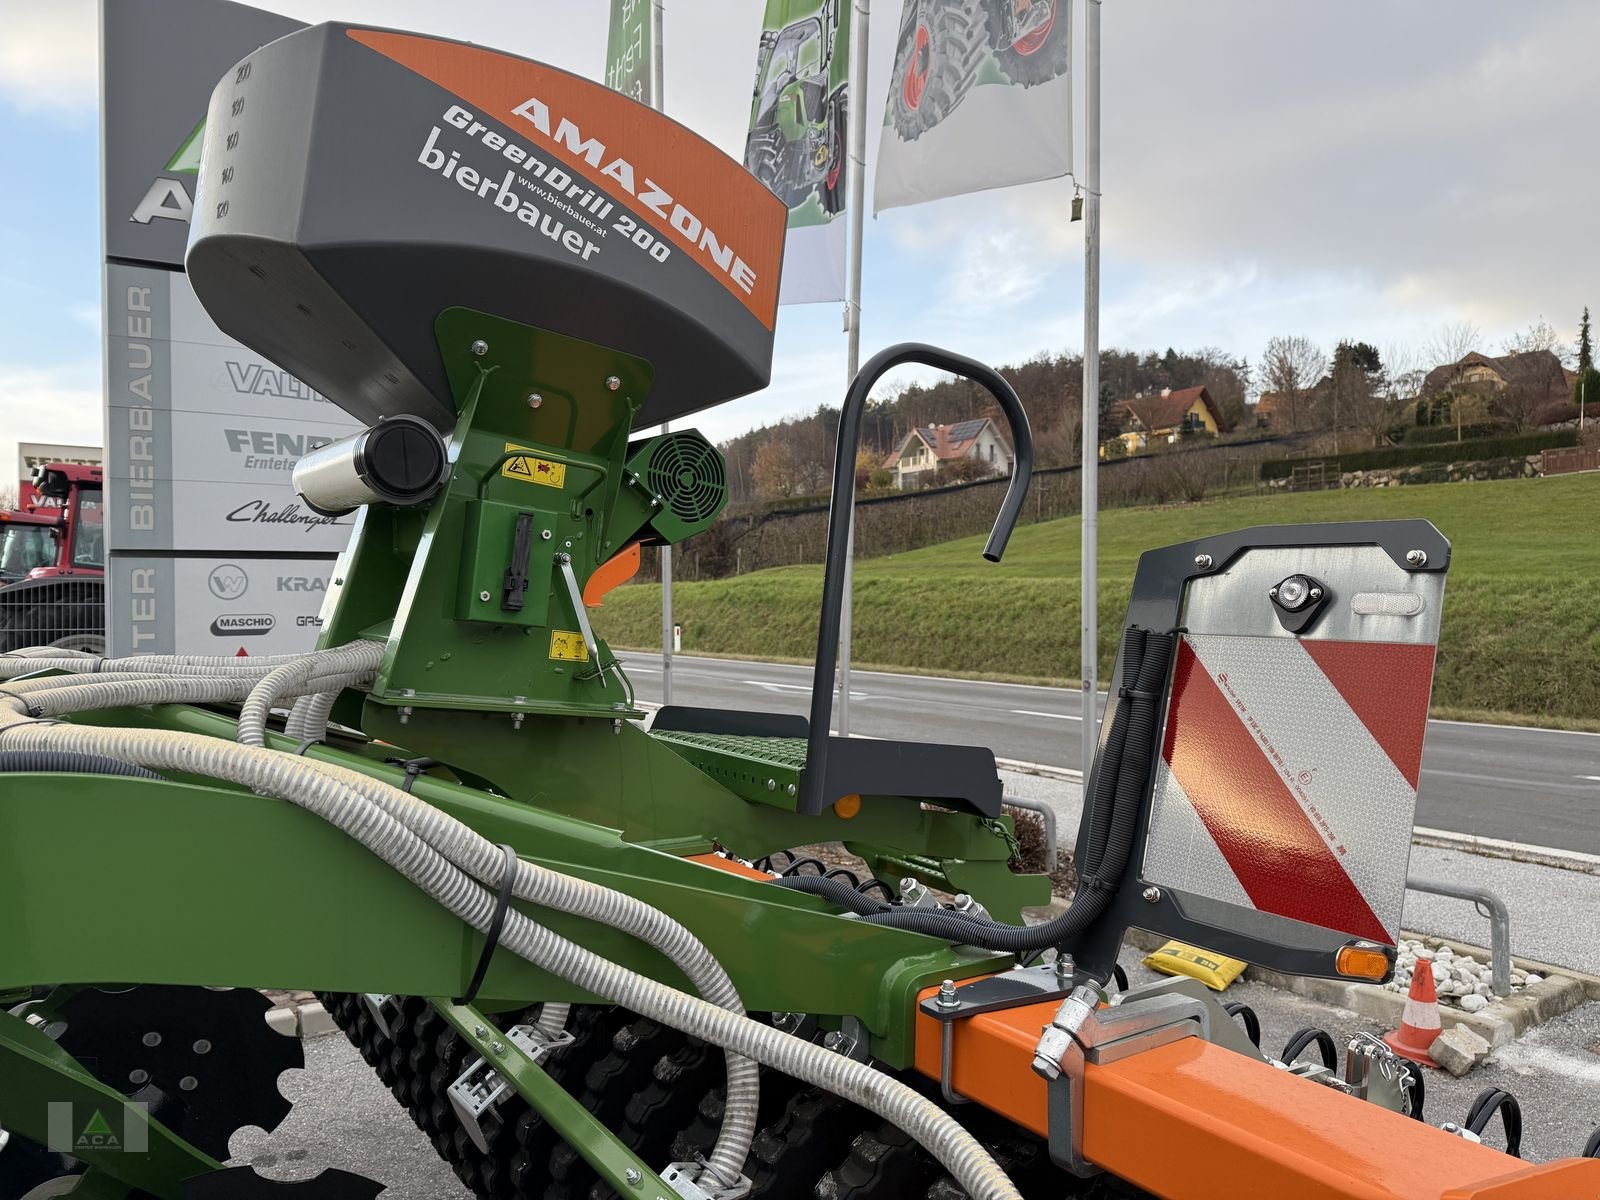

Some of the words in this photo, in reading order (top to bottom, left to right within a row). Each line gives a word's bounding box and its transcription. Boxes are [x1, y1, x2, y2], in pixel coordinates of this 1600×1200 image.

[235, 62, 252, 84] 200
[216, 200, 230, 219] 120
[417, 126, 601, 261] bierbauer
[442, 104, 614, 221] GreenDrill
[612, 215, 671, 263] 200
[511, 97, 757, 295] AMAZONE
[517, 174, 607, 238] www.bierbauer.at
[127, 286, 155, 531] BIERBAUER
[225, 500, 354, 533] Challenger
[220, 617, 273, 627] MASCHIO
